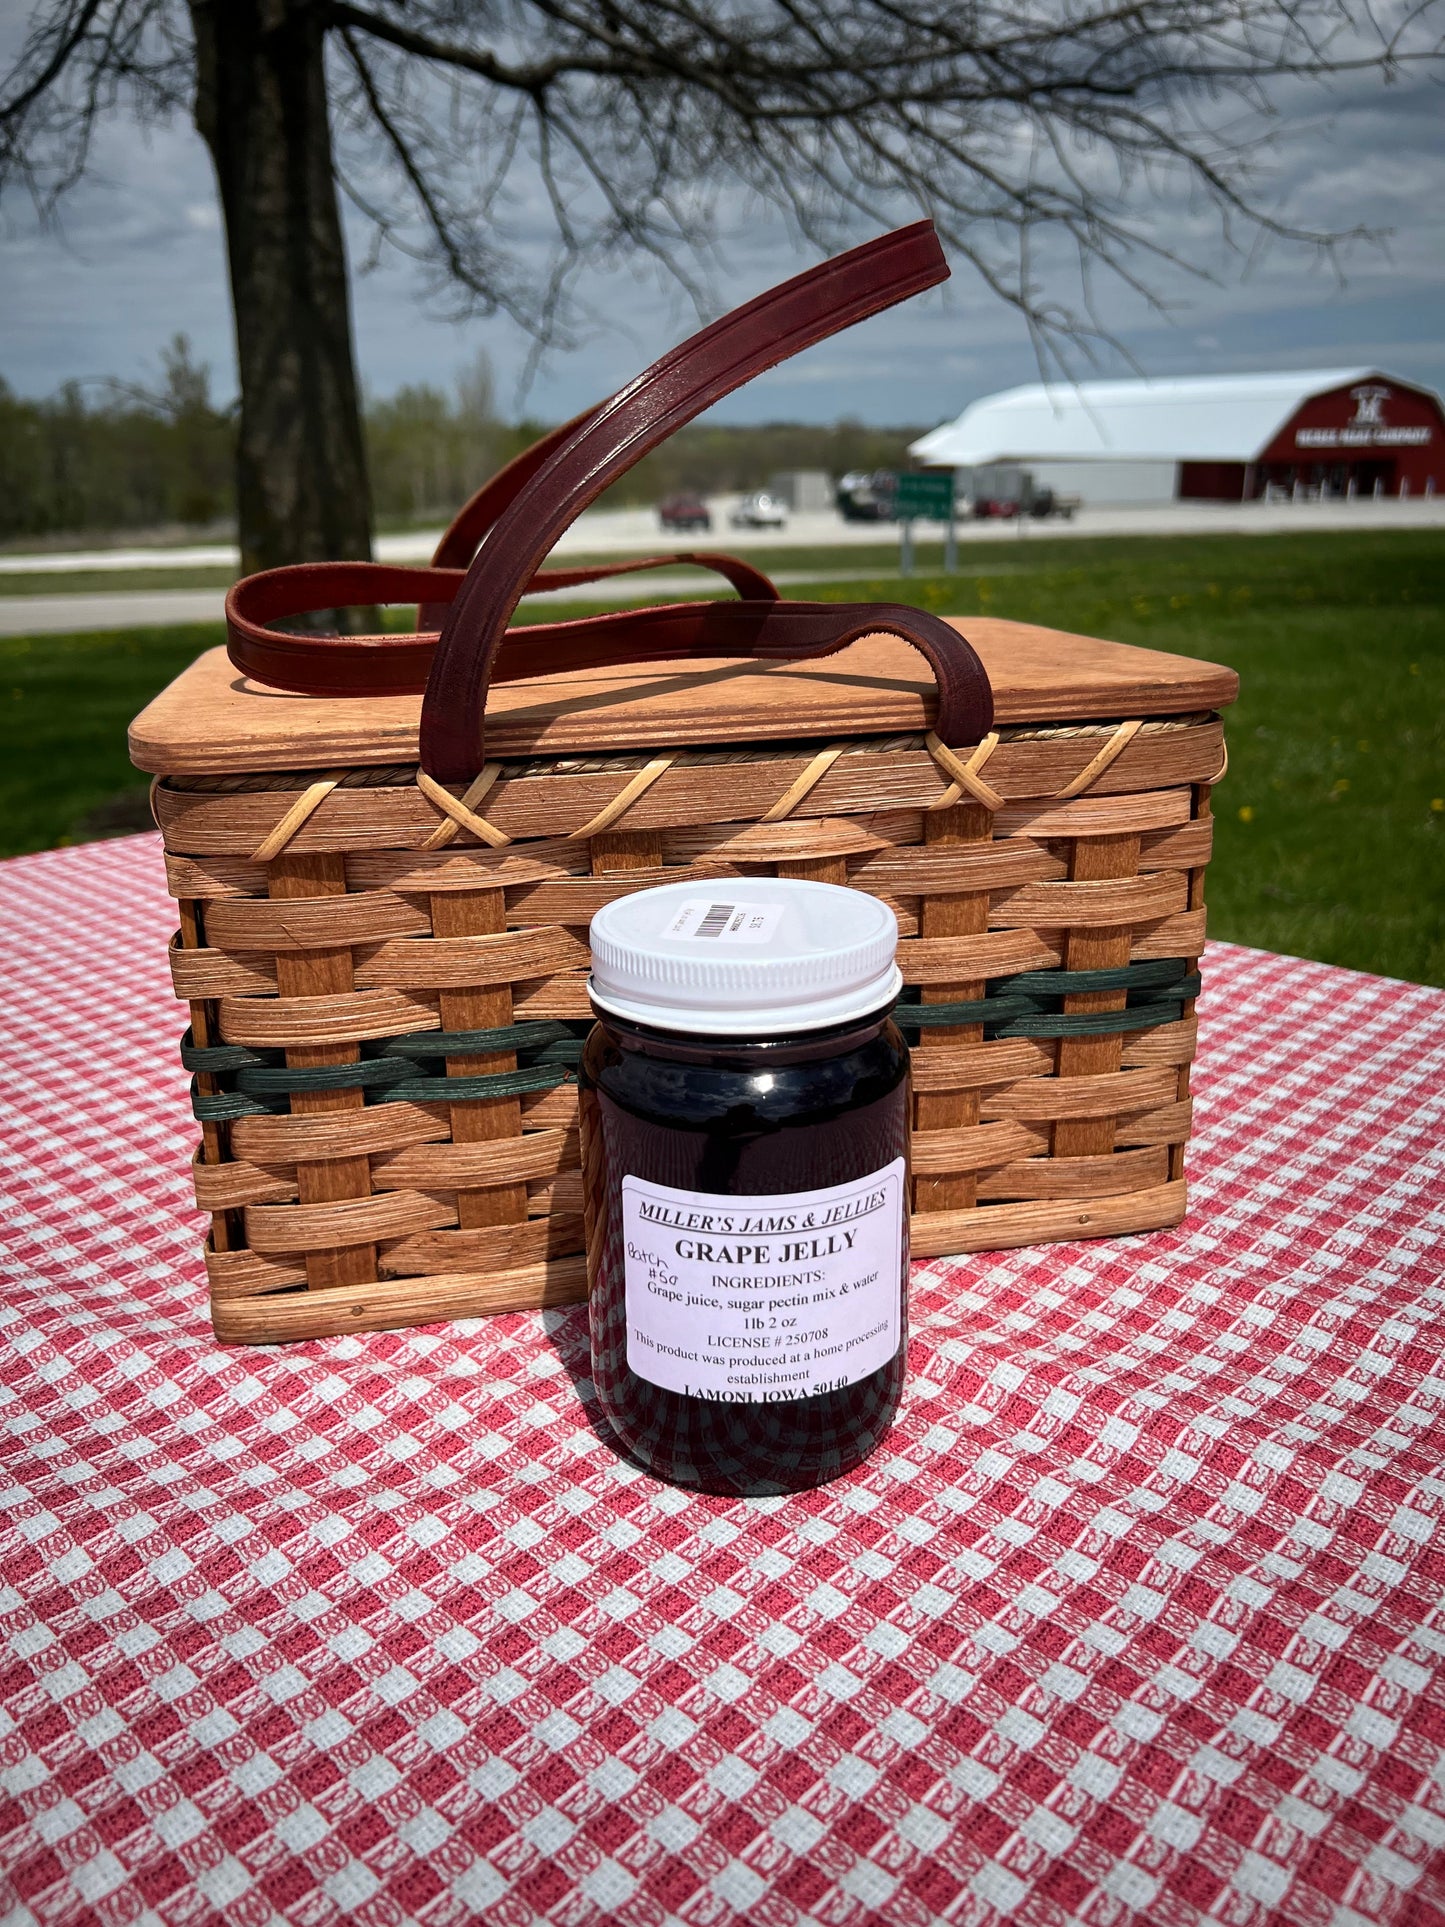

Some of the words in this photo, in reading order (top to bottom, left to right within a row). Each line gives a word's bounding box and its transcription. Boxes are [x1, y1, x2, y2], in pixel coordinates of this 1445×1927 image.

[639, 1201, 734, 1232] MILLER'S
[739, 1215, 797, 1232] JAMS
[801, 1212, 815, 1228] &
[821, 1187, 886, 1224] JELLIES
[675, 1239, 770, 1264] GRAPE
[778, 1228, 857, 1262] JELLY
[647, 1281, 683, 1302] Grape
[685, 1292, 723, 1310] juice,
[727, 1300, 765, 1312] sugar
[769, 1293, 809, 1311] pectin
[812, 1288, 836, 1302] mix
[840, 1283, 849, 1296] &
[853, 1271, 879, 1290] water
[712, 1269, 826, 1288] INGREDIENTS:
[769, 1317, 777, 1329] 2
[781, 1318, 797, 1328] oz
[634, 1329, 655, 1348] This
[656, 1342, 698, 1361] product
[702, 1355, 725, 1365] was
[729, 1354, 786, 1368] produced
[789, 1354, 801, 1364] at
[803, 1353, 811, 1361] a
[813, 1343, 844, 1359] home
[845, 1320, 889, 1352] processing
[707, 1335, 770, 1348] LICENSE
[774, 1336, 782, 1347] #
[785, 1328, 829, 1346] 250708
[727, 1369, 810, 1385] establishment
[762, 1388, 809, 1402] IOWA
[812, 1375, 848, 1395] 50140
